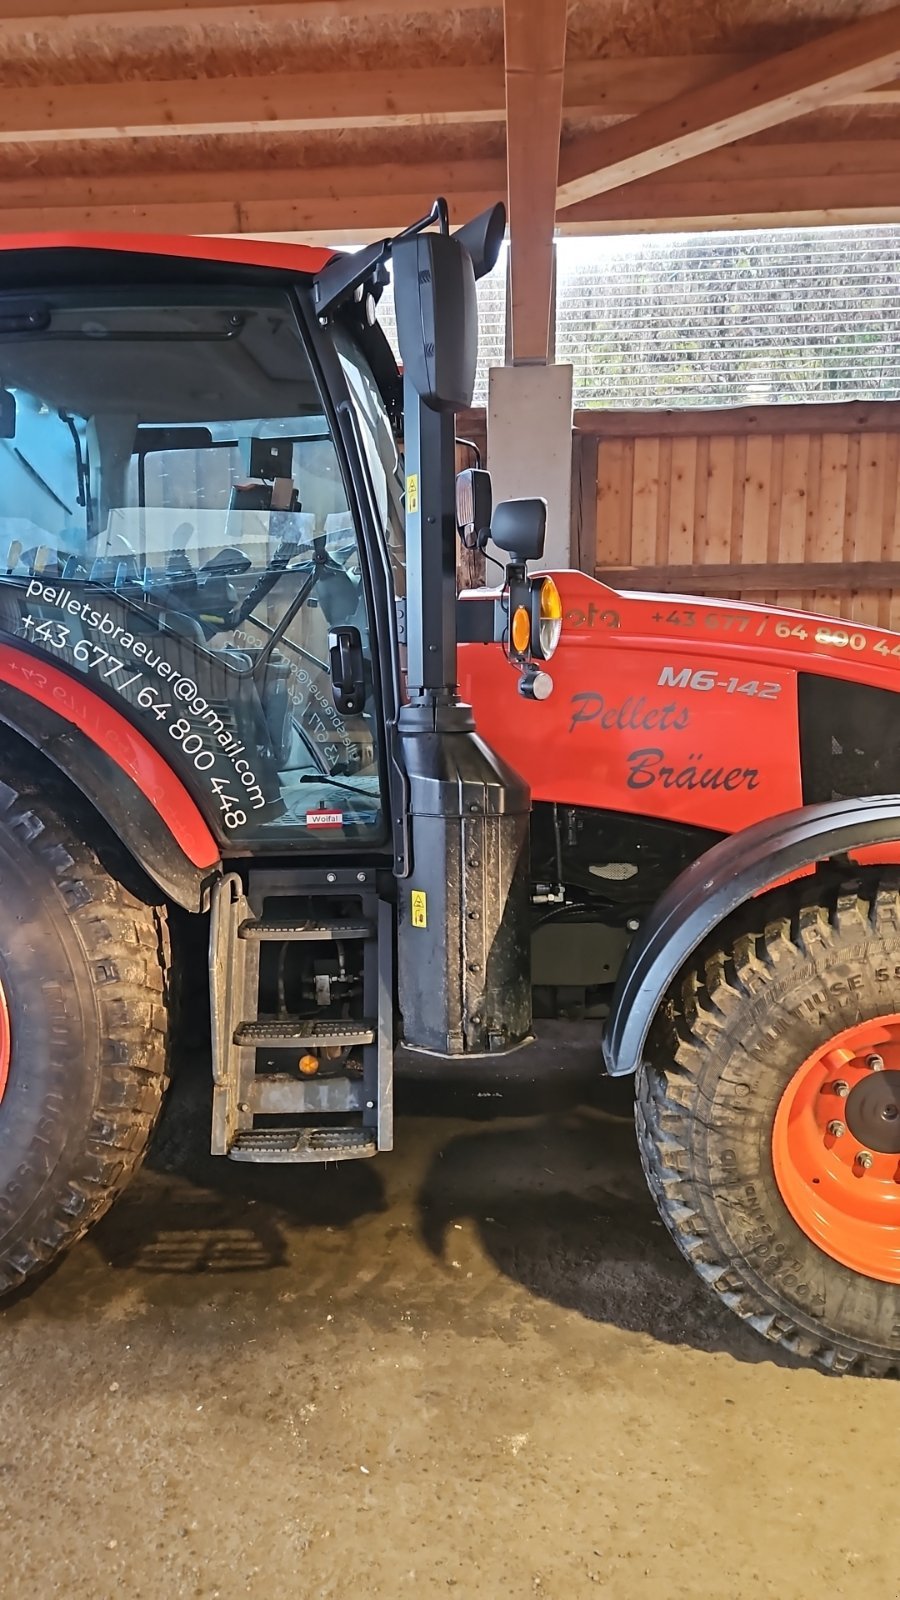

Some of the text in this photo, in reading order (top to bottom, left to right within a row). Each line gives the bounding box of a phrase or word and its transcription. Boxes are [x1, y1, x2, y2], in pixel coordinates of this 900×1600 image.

[651, 609, 697, 628] +43
[704, 612, 751, 633] 677
[775, 621, 808, 641] 64
[814, 626, 867, 651] 800
[25, 578, 266, 810] pelletsbraeuer@gmail.com
[657, 666, 782, 700] M6-142
[21, 614, 248, 830] +43 677 / 64 800 448
[568, 690, 690, 733] Pellets
[626, 748, 760, 792] Bräuer
